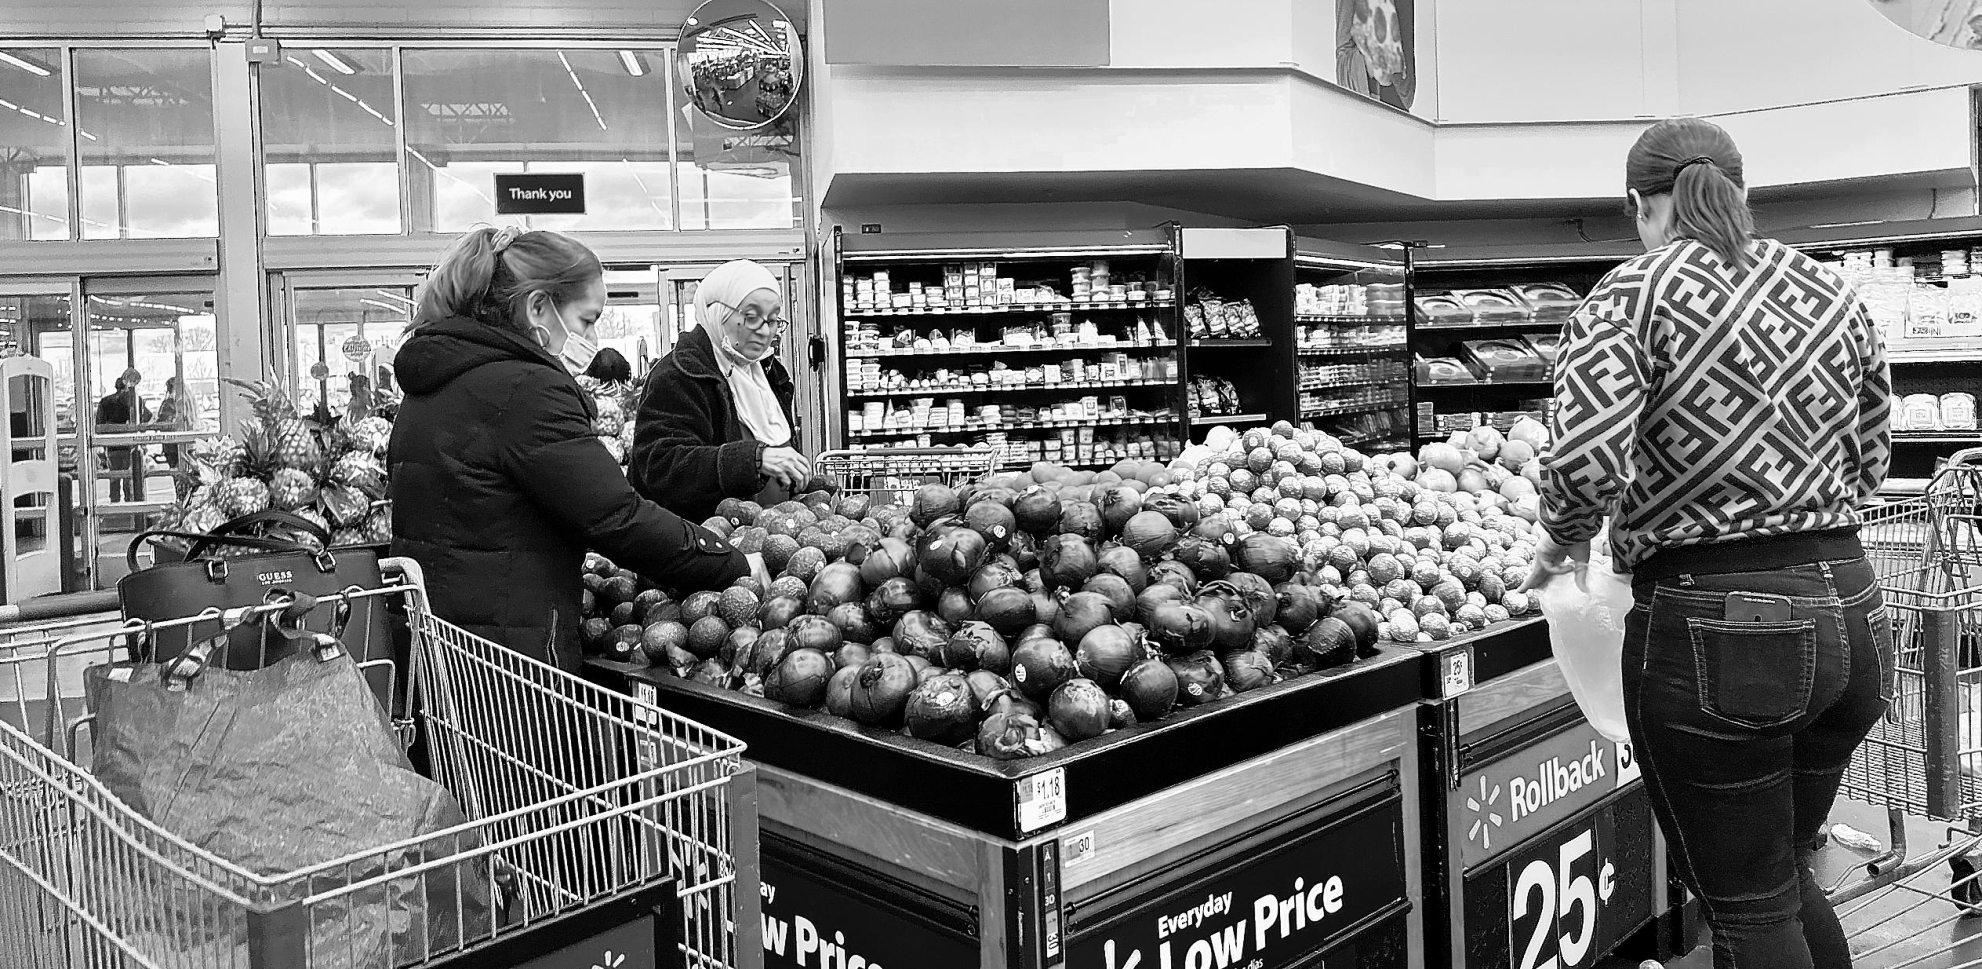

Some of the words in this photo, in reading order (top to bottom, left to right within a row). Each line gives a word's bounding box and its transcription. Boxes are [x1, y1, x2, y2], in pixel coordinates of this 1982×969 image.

[508, 187, 547, 200] Thank
[548, 189, 572, 202] you
[258, 570, 293, 581] GUESS
[1037, 776, 1060, 800] $1.18
[1509, 739, 1606, 823] Rollback
[1078, 836, 1090, 854] 30
[1045, 894, 1056, 907] 30
[1513, 829, 1615, 969] 25¢
[1158, 891, 1232, 939] Everyday
[1254, 875, 1344, 951] Price
[794, 914, 884, 969] Pri
[1048, 934, 1059, 950] 30
